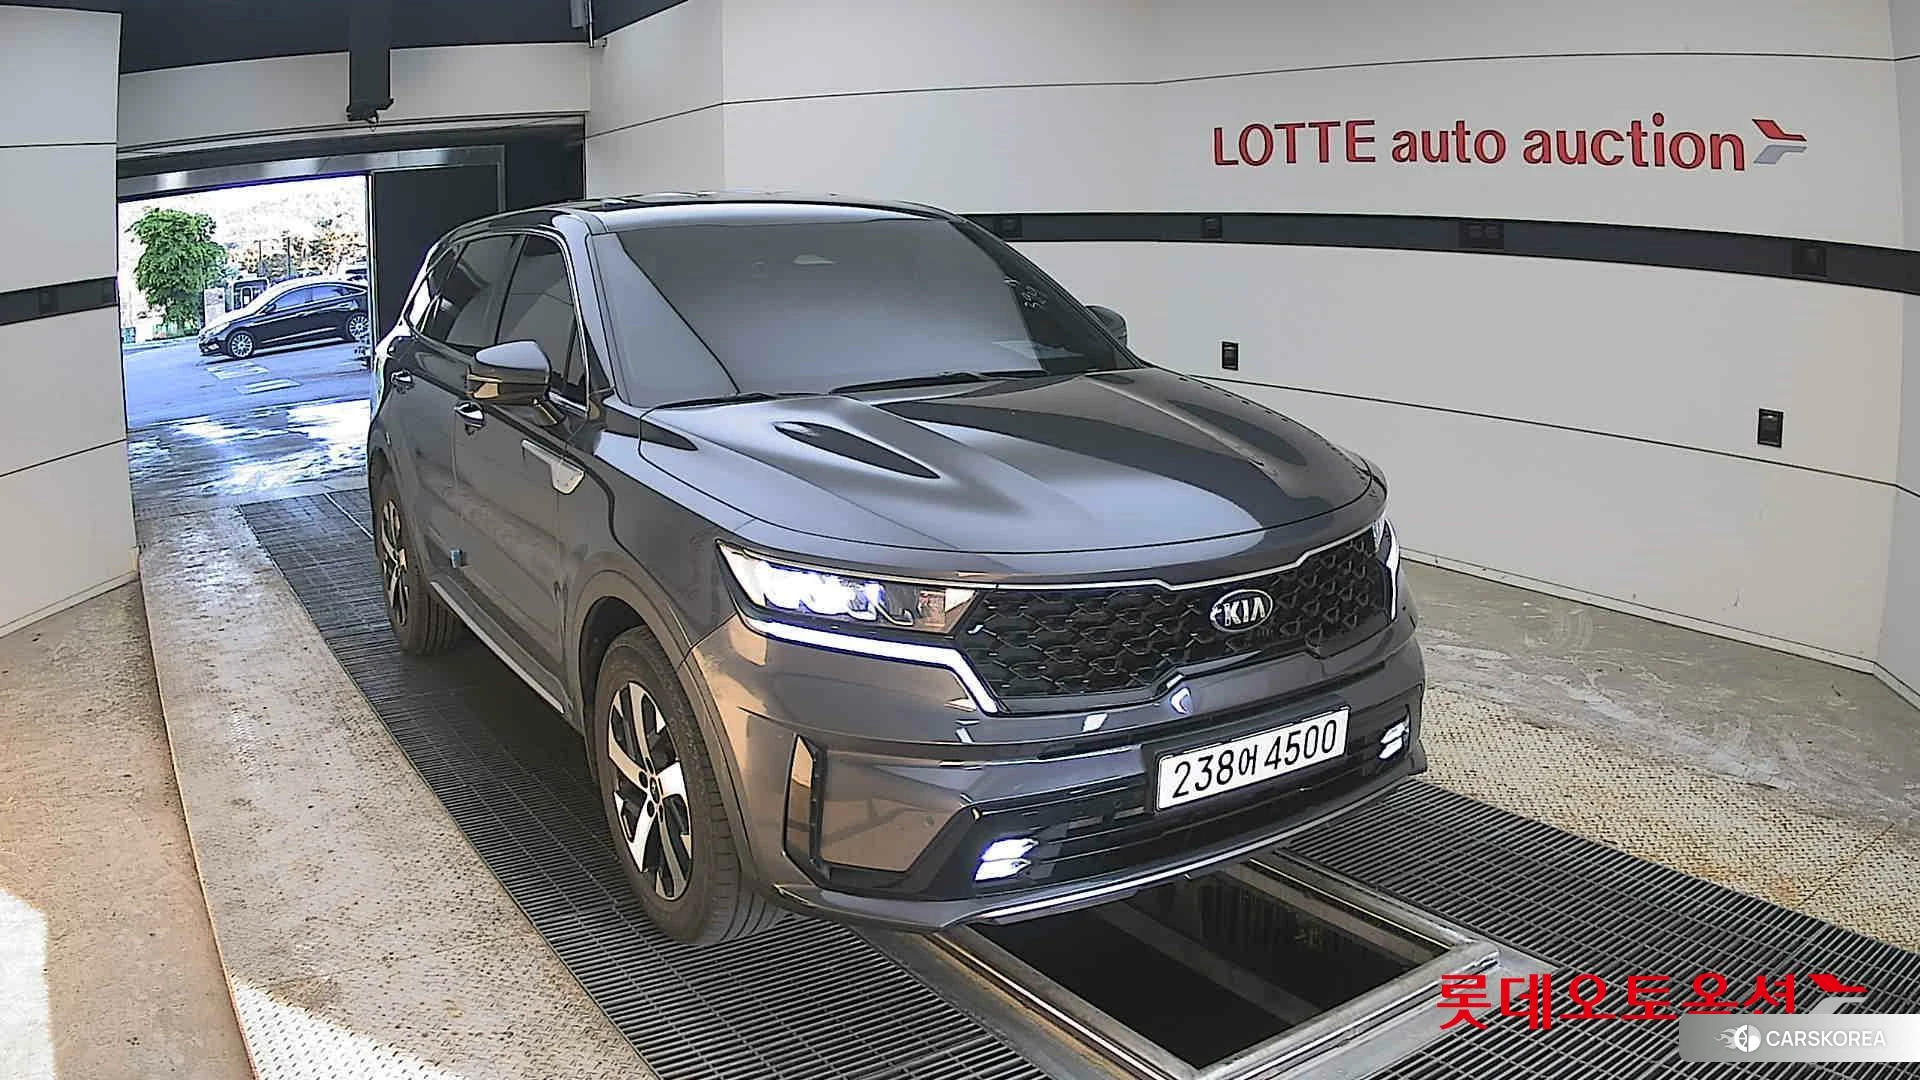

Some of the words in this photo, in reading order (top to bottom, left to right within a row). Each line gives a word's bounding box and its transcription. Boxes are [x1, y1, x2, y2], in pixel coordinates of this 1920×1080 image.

[1213, 119, 1377, 167] LOTTE
[1391, 119, 1507, 165] auto
[1522, 112, 1746, 172] auction
[1222, 596, 1267, 627] KIA
[1171, 743, 1259, 799] 238어
[1263, 719, 1338, 770] 4500
